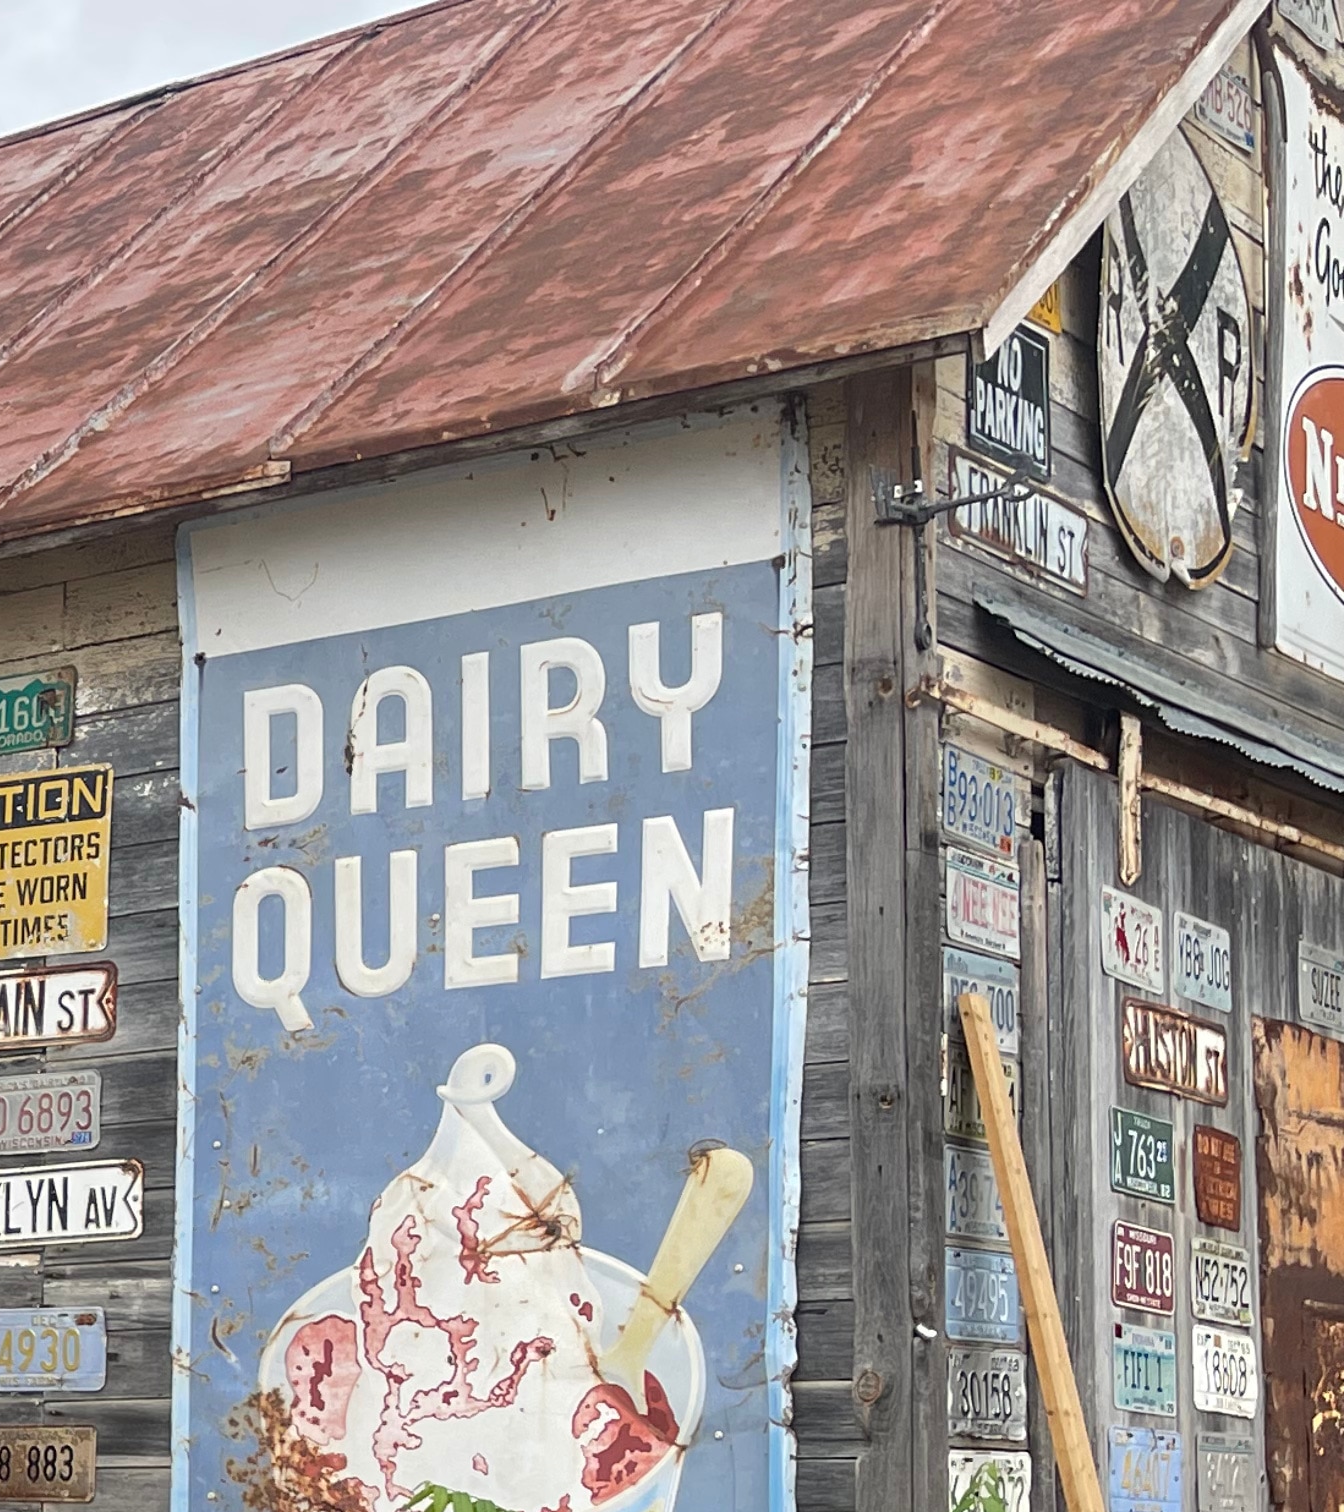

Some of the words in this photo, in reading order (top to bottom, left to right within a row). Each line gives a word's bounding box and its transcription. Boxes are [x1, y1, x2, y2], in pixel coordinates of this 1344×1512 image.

[997, 336, 1023, 392] NO
[976, 377, 1045, 461] PARKING
[968, 461, 1049, 569] FRANKLIN
[1058, 525, 1075, 579] ST
[243, 612, 723, 830] DAIRY
[16, 873, 88, 906] WORN
[0, 914, 70, 947] TIMES
[231, 807, 735, 1031] QUEEN
[1135, 922, 1149, 966] 26
[57, 989, 95, 1031] ST
[17, 1089, 92, 1135] 6893
[1128, 1130, 1155, 1180] 763
[84, 1186, 119, 1229] AV
[1129, 1229, 1157, 1245] MISSOURI
[1115, 1240, 1141, 1290] F9F
[1145, 1249, 1172, 1297] 818
[955, 1269, 1010, 1323] 49495
[958, 1370, 1012, 1420] 30158
[1205, 1348, 1247, 1397] 18808
[27, 1444, 74, 1483] 883
